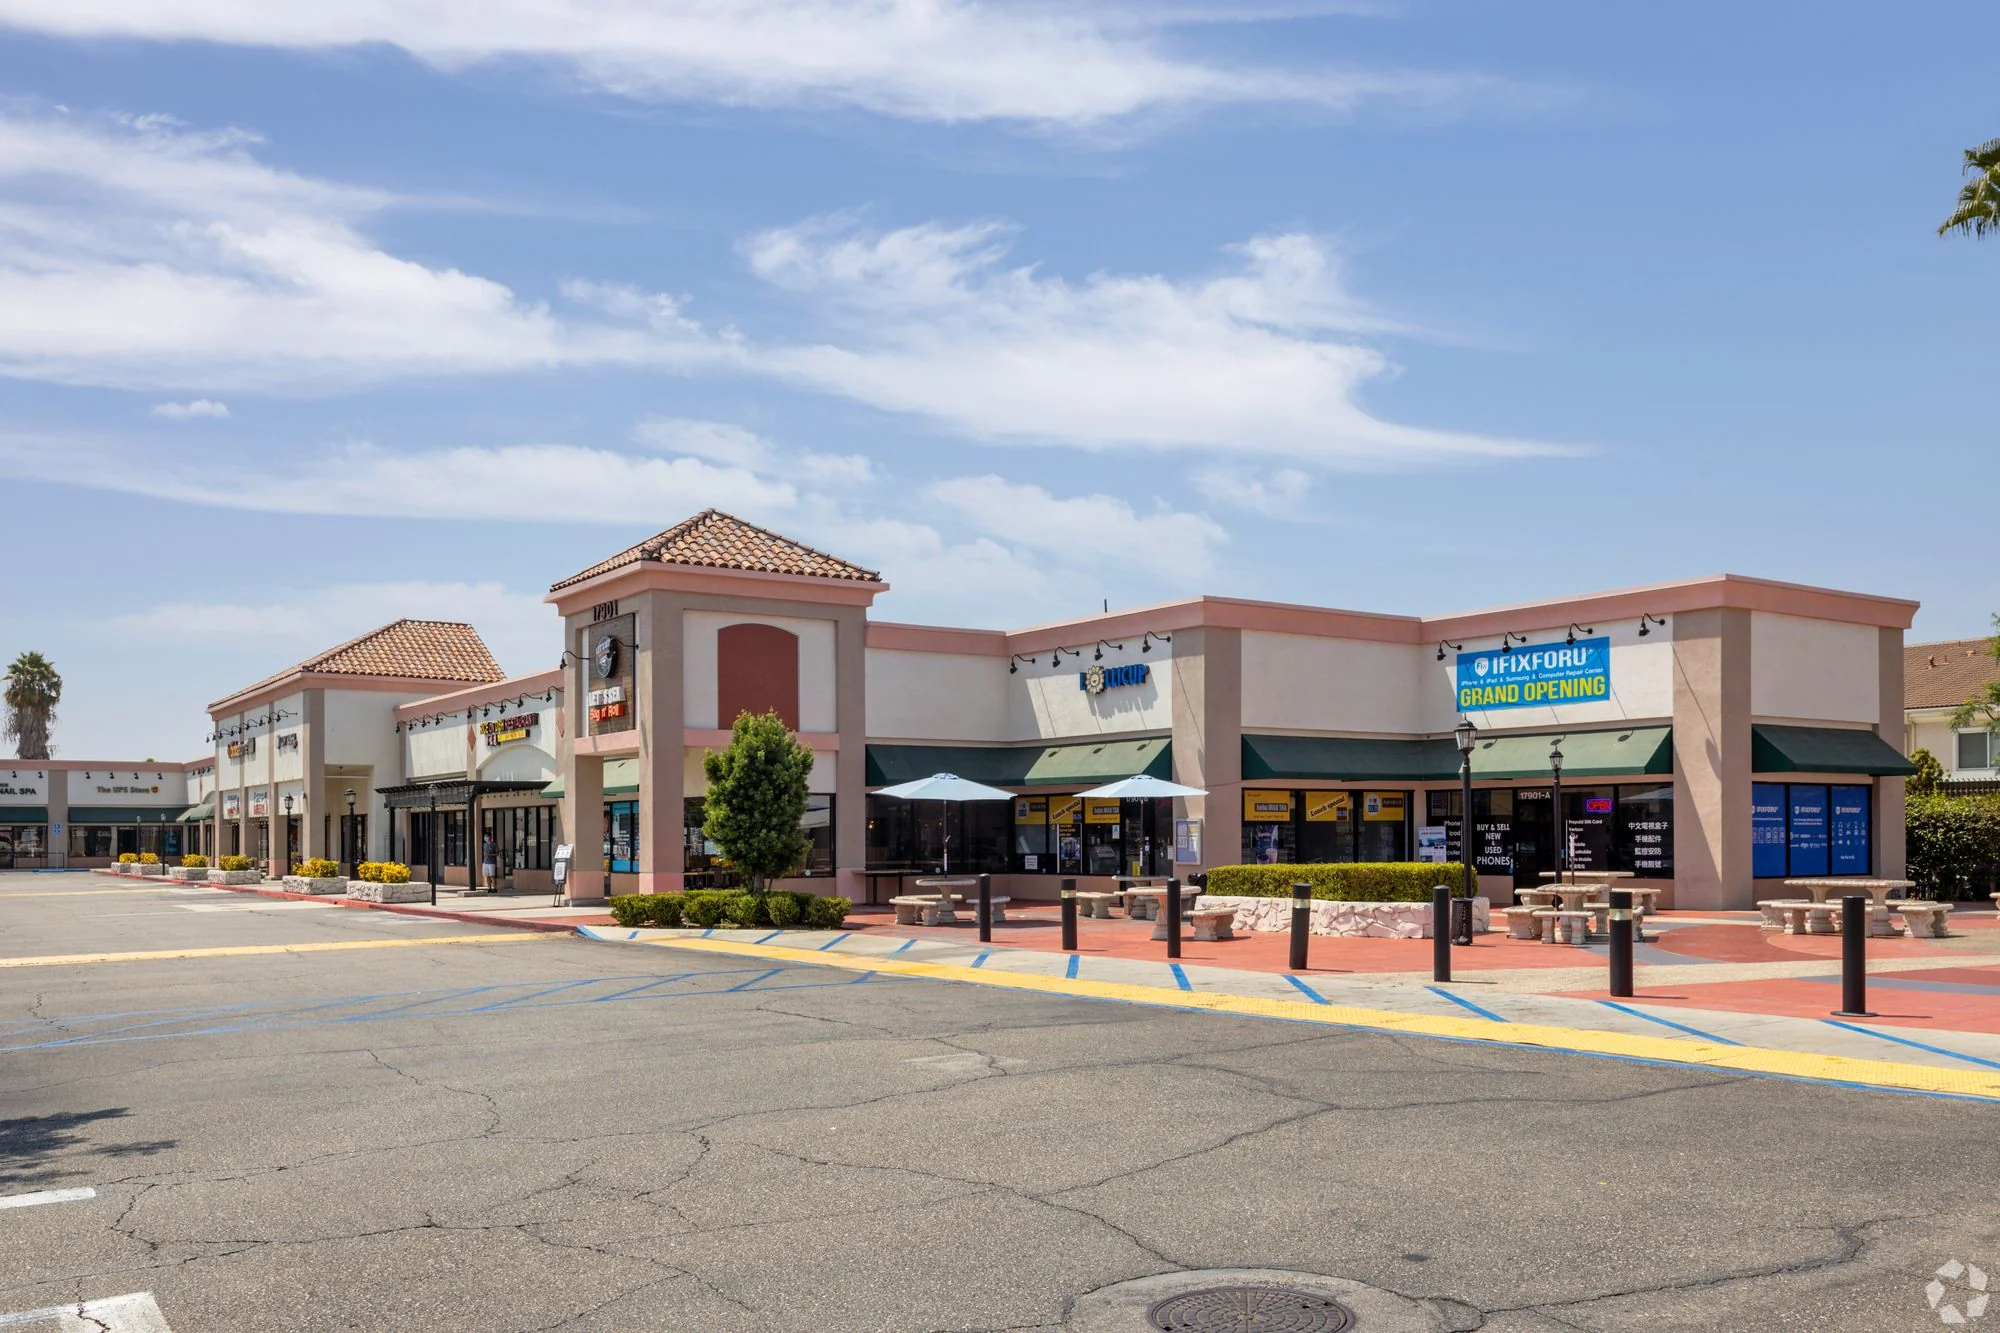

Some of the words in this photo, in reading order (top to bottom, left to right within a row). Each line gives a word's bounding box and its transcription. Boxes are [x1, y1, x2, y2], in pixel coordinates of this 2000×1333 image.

[593, 600, 618, 621] 17901
[1493, 647, 1587, 675] IFIXFORU
[1538, 671, 1565, 679] Computer
[1566, 669, 1584, 677] Repair
[1584, 667, 1604, 675] Center
[1460, 684, 1519, 707] GRAND
[1523, 676, 1606, 702] OPENING
[1519, 791, 1551, 800] 17901-A
[1310, 805, 1327, 817] Lunch
[1327, 796, 1345, 809] special
[1588, 801, 1611, 810] OPEN
[1476, 823, 1489, 831] BUY
[1496, 823, 1510, 831] SELL
[1485, 832, 1501, 840] NEW
[1484, 846, 1502, 854] USED
[1476, 856, 1511, 866] PHONES
